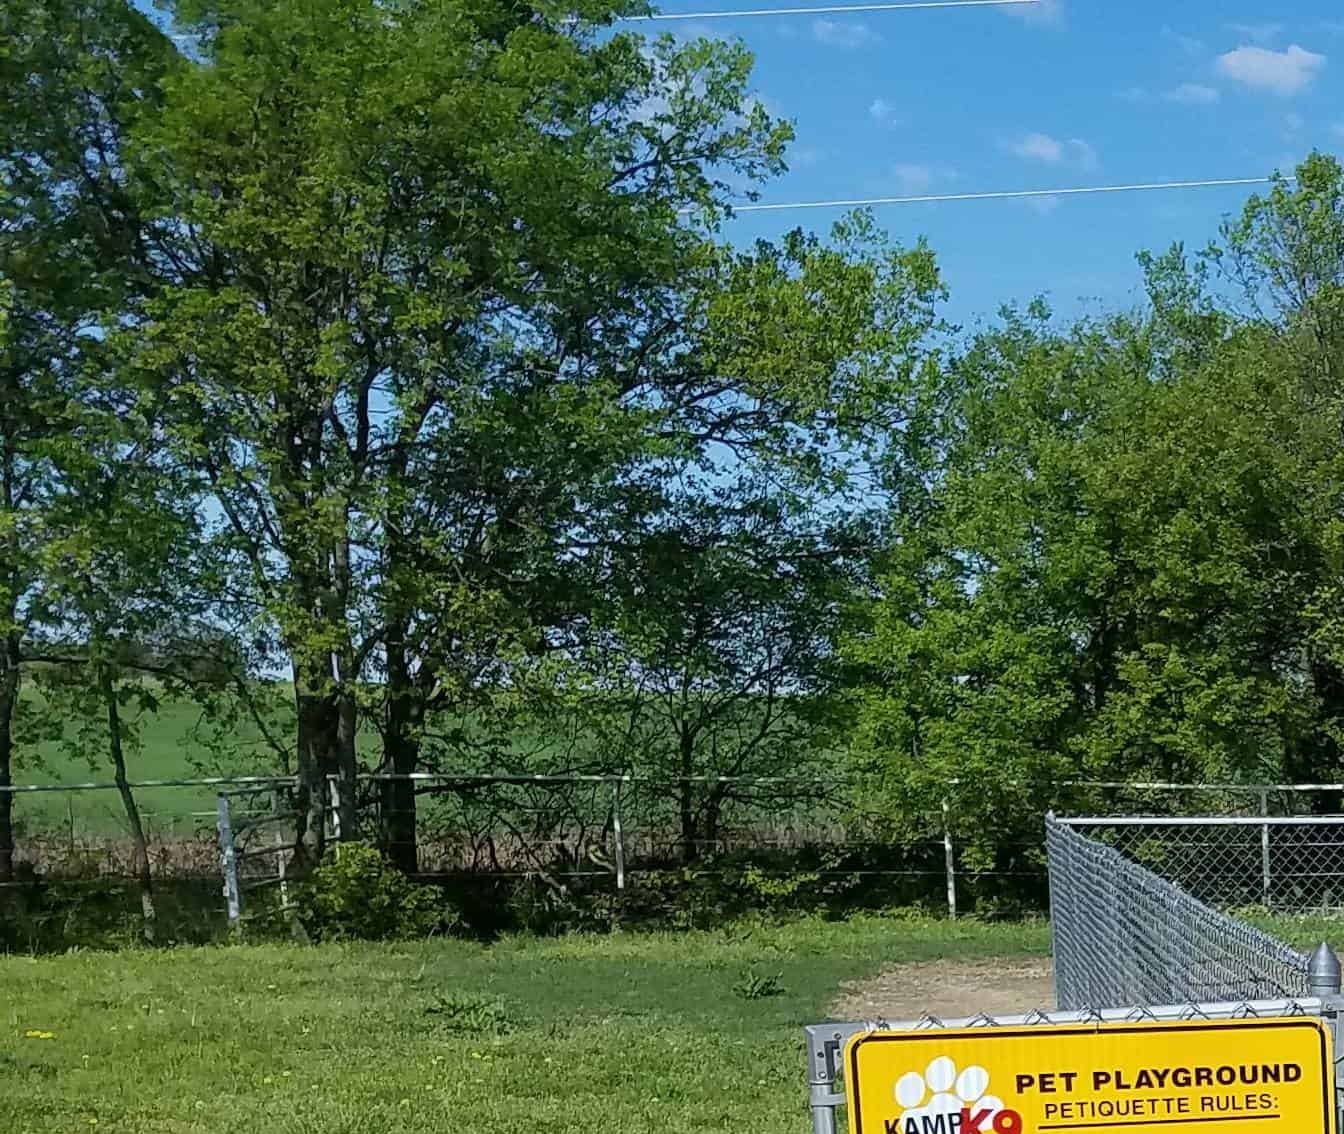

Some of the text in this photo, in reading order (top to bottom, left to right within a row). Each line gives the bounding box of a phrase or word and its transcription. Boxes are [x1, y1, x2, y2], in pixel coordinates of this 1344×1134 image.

[1016, 1063, 1302, 1094] PET PLAYGROUND
[1044, 1094, 1280, 1119] PETIQUETTE RULES:
